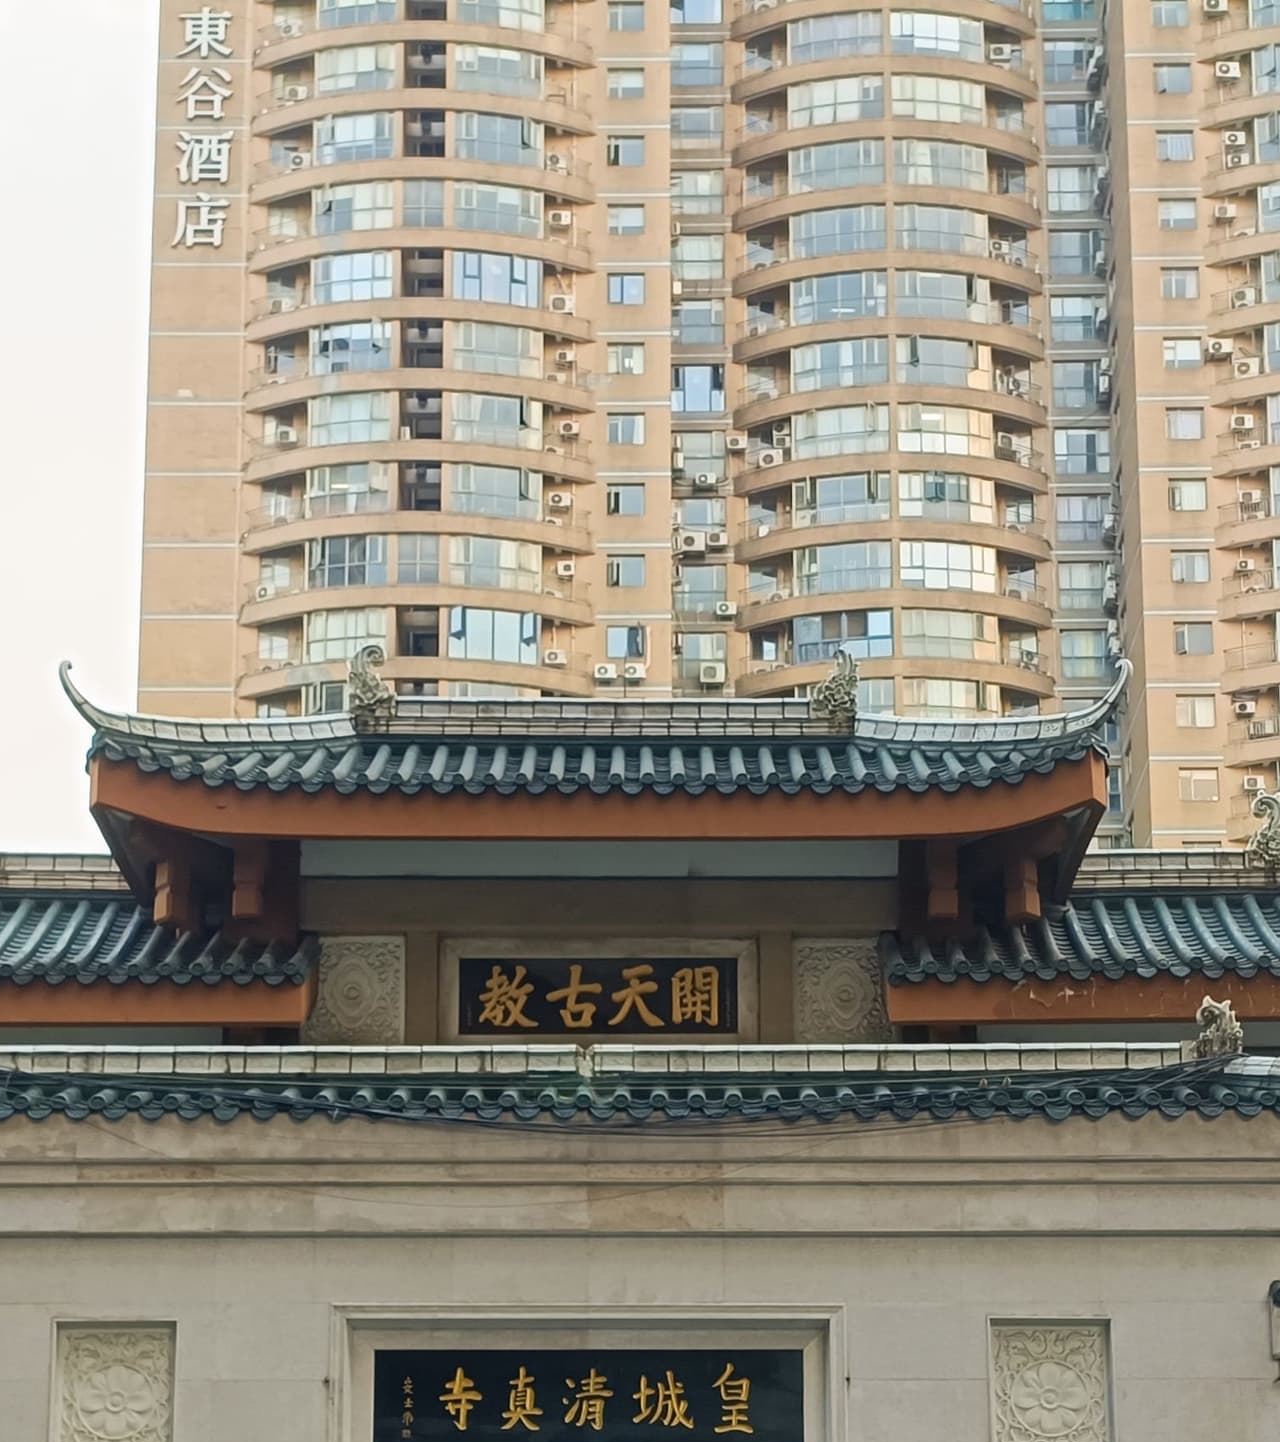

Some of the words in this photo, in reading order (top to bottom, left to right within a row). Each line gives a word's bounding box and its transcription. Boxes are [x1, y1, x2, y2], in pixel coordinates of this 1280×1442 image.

[171, 7, 234, 248] 東谷酒店
[438, 1361, 754, 1435] 皇城清真寺
